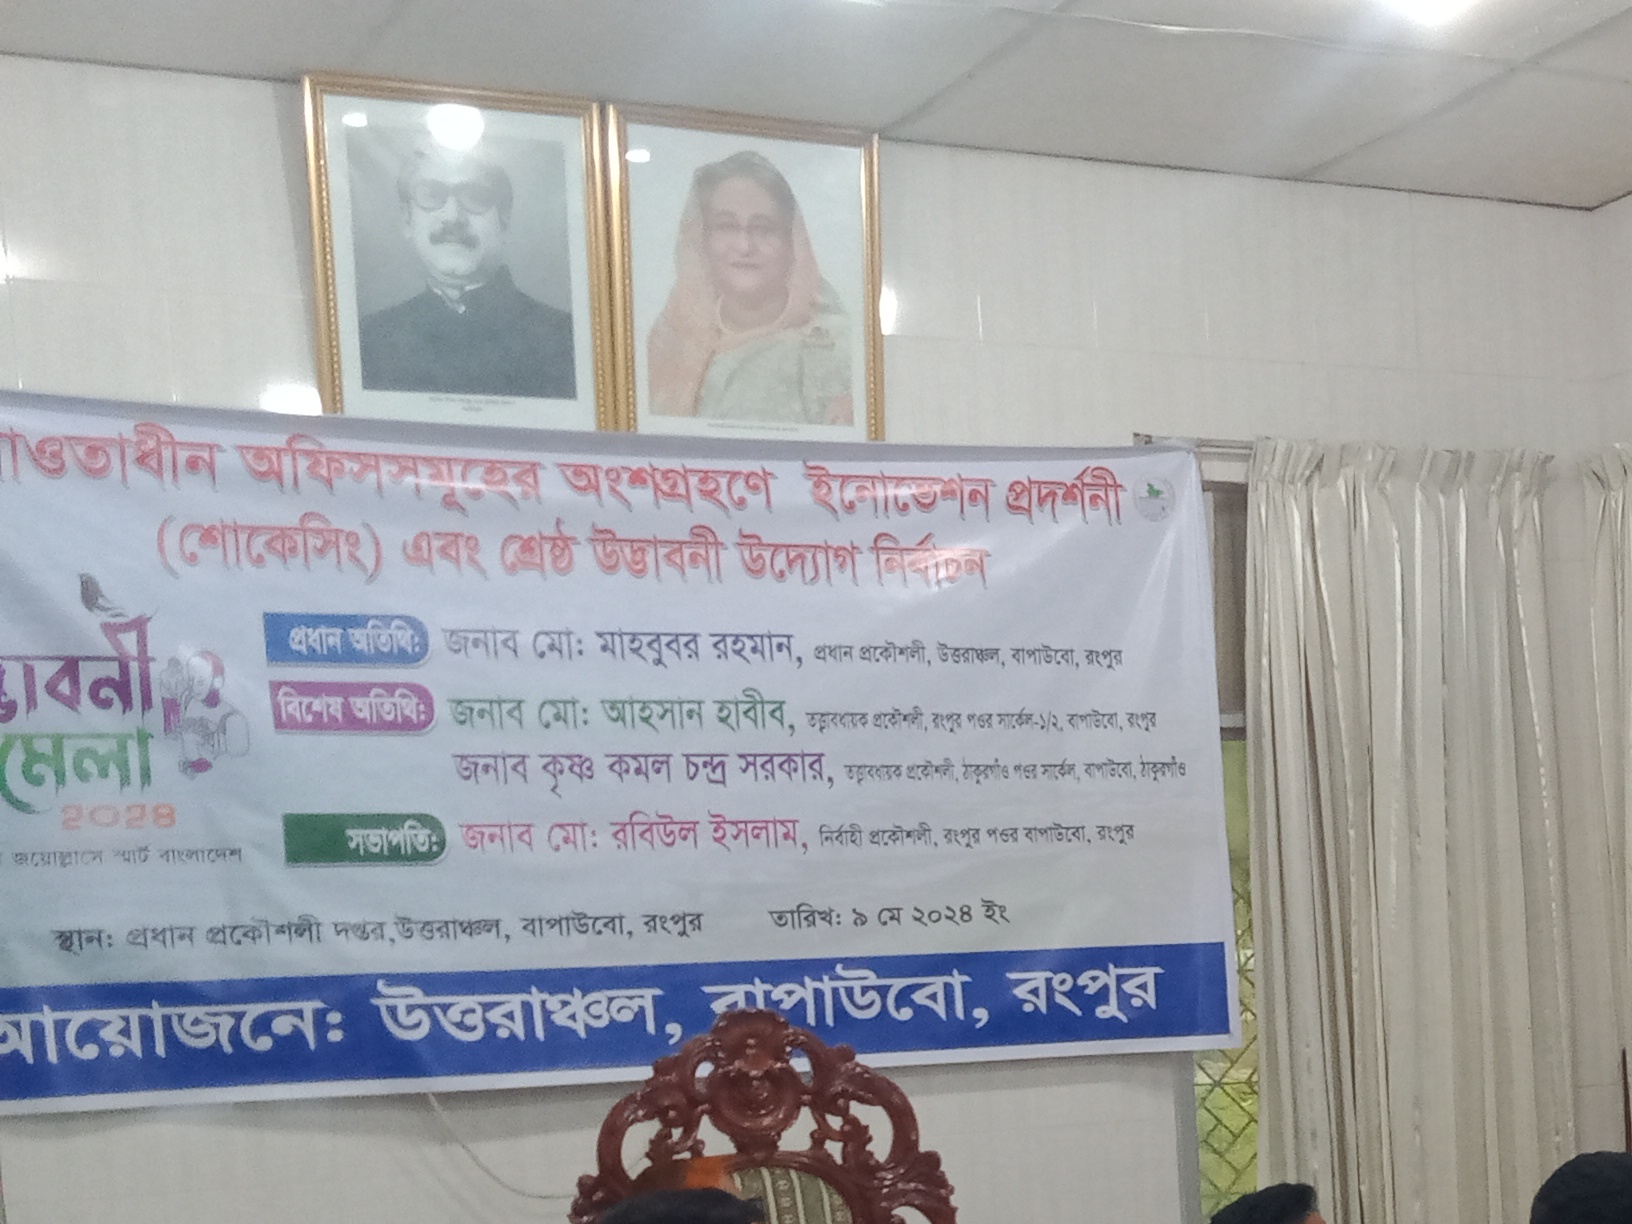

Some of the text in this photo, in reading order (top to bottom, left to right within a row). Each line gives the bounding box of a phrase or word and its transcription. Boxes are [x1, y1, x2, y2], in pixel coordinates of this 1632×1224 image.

[236, 432, 546, 517] অফিসসমূহের
[555, 460, 777, 519] অংশগ্রহণে
[802, 459, 996, 523] ইনোভেশন
[1005, 464, 1128, 524] প্রদর্শনী
[156, 511, 990, 590] (শোকেসিং) এবং শ্রেষ্ঠ উদ্ভাবনী উদ্যোগ নির্বাচন
[289, 625, 344, 655] প্রধান
[441, 628, 519, 659] জনাব
[594, 628, 701, 668] মাহবুবর
[710, 630, 804, 669] রহমান,
[814, 645, 853, 664] প্রধান
[1085, 648, 1123, 671] রংপুর
[277, 686, 344, 724] বিশেষ
[447, 695, 525, 730] জনাব
[600, 696, 704, 732] আহসান
[712, 688, 796, 737] হাবীব,
[932, 711, 962, 734] রংপুর
[1126, 711, 1157, 733] রংপুর
[453, 751, 530, 786] জনাব
[539, 751, 596, 799] কৃষ্ণ
[605, 751, 675, 784] কমল
[683, 751, 730, 786] চন্দ্র
[737, 750, 835, 790] সরকার,
[458, 820, 534, 855] জনাব
[610, 810, 700, 852] রবিউল
[707, 810, 808, 855] ইসলাম,
[943, 826, 982, 849] রংপুর
[1096, 823, 1136, 847] রংপুর
[125, 923, 195, 951] প্রধান
[205, 913, 322, 949] প্রকৌশলী
[641, 909, 704, 938] রংপুর
[851, 906, 868, 927] ৯
[877, 905, 903, 927] মে
[912, 903, 973, 927] ২০২৪
[980, 898, 1011, 926] ইং
[1005, 962, 1165, 1023] রংপুর
